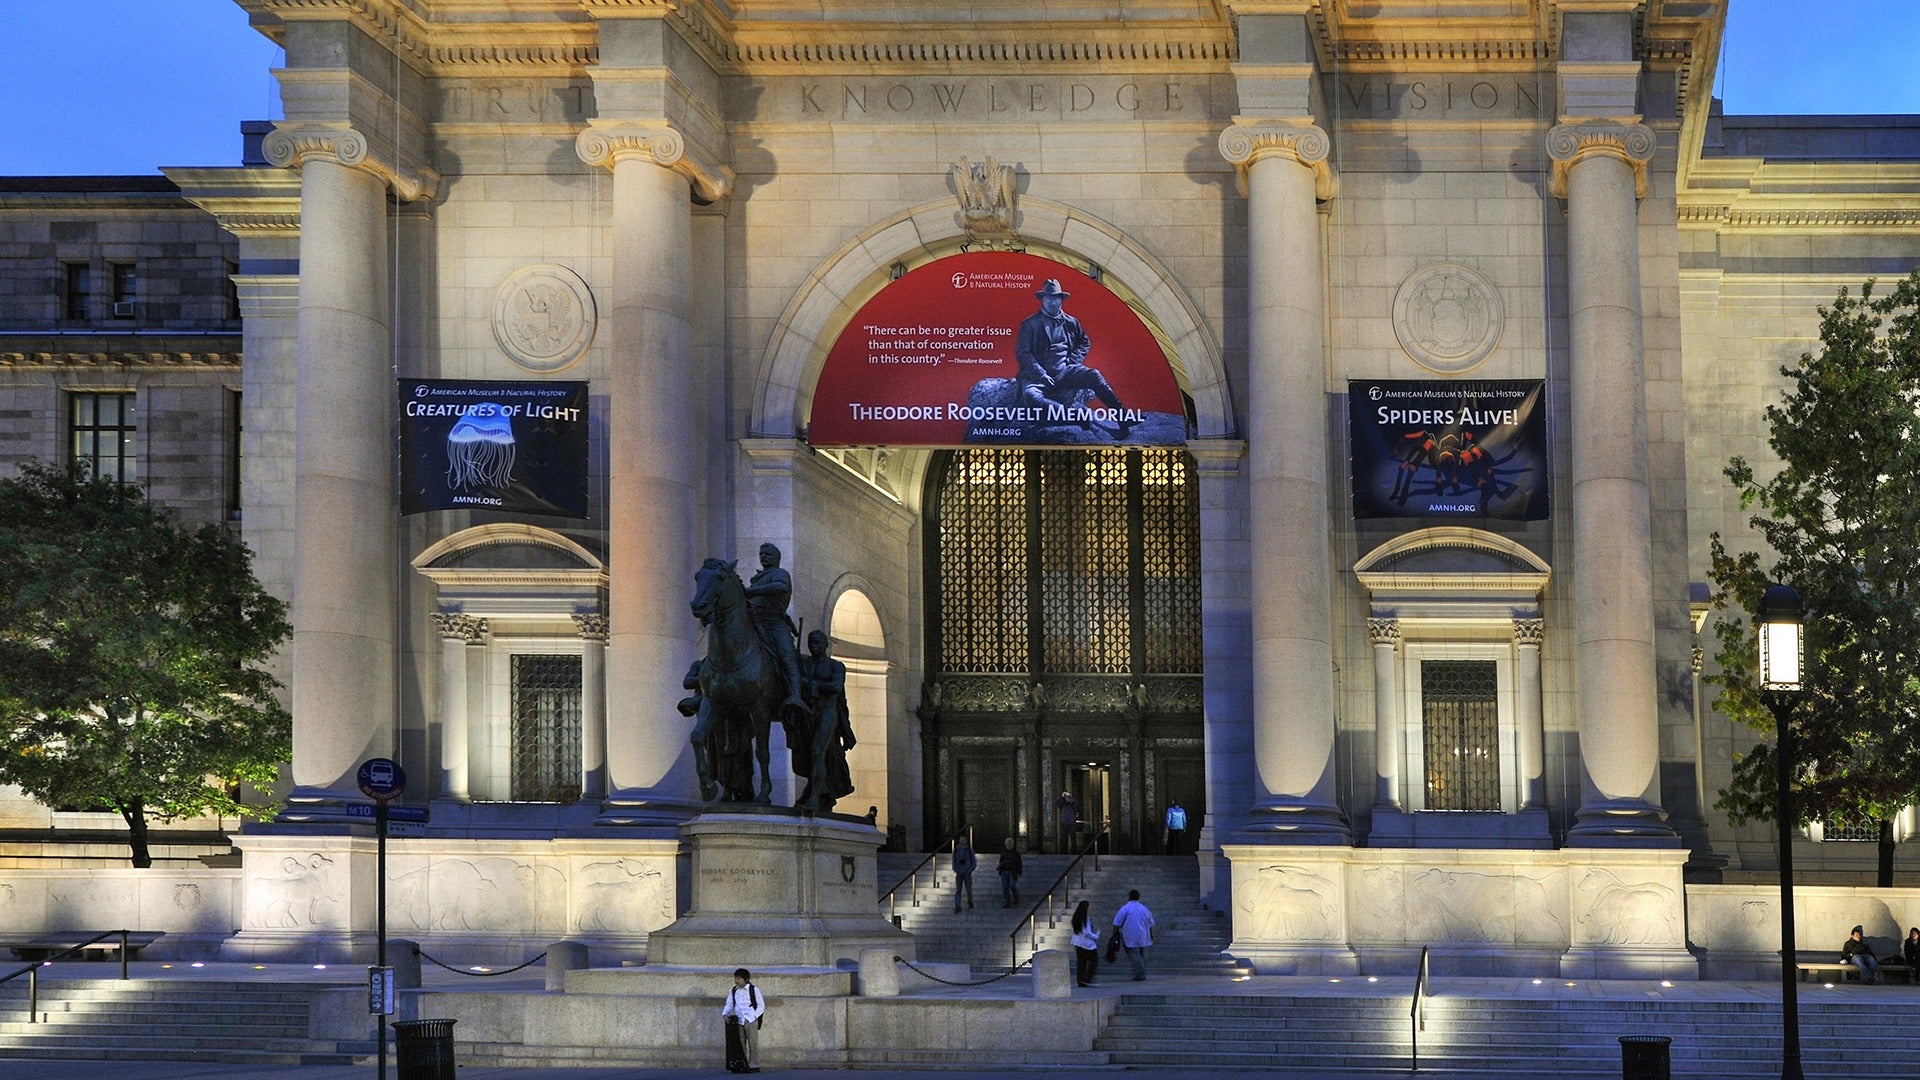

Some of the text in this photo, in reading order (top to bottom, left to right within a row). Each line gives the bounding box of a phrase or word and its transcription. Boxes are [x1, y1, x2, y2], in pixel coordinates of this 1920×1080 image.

[446, 86, 592, 114] TRUT
[800, 83, 1183, 113] KNOWLEDGE
[1343, 81, 1541, 111] VISION
[918, 325, 930, 335] be
[948, 326, 984, 338] greater
[986, 326, 1011, 335] issue
[868, 339, 994, 350] than that of conservation
[868, 354, 878, 363] in
[880, 354, 899, 364] this
[430, 388, 467, 396] AMERICAN
[467, 389, 499, 397] MUSEUM
[506, 389, 537, 397] NATURAL
[1384, 390, 1423, 398] AMERICAN
[1423, 390, 1456, 398] MUSEUM
[1463, 390, 1495, 398] NATURAL
[1496, 390, 1526, 398] HISTORY
[406, 401, 580, 421] CREATURES OF LIGHT
[849, 403, 1145, 422] THEODORE ROOSEVELT MEMORIAL
[1378, 406, 1518, 425] SPIDERS ALIVE!
[972, 428, 1021, 436] AMNH.ORG
[452, 496, 502, 506] AMNH.ORG
[1428, 504, 1476, 512] AMNH.ORG
[349, 805, 371, 815] M10
